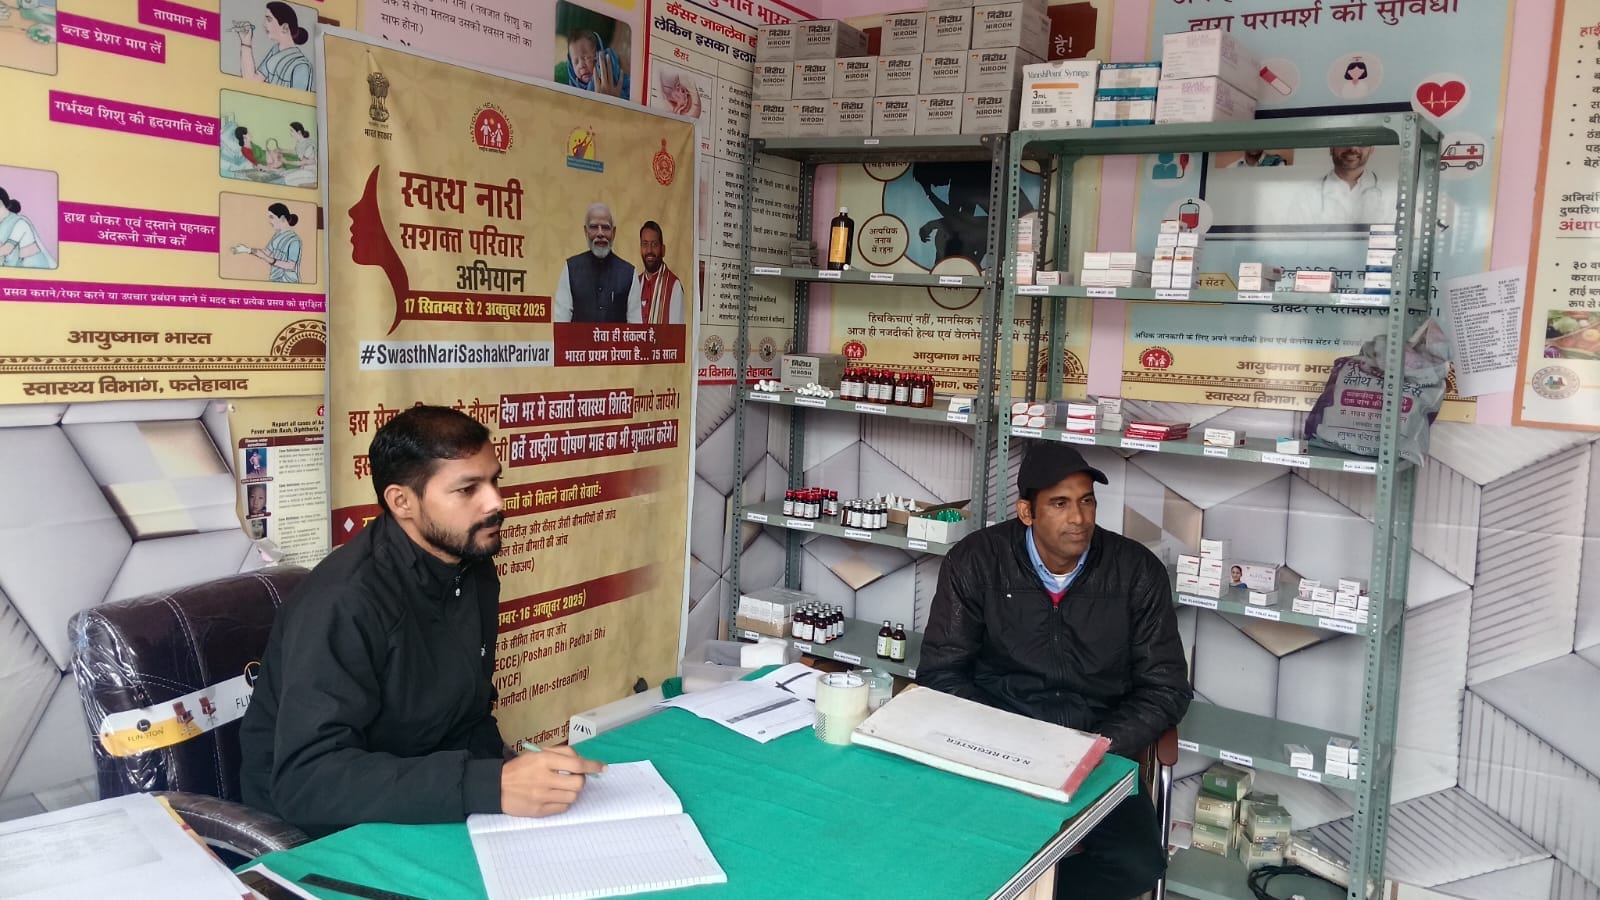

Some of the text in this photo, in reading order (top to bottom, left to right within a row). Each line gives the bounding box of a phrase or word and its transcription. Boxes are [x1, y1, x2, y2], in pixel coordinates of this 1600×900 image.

[154, 8, 208, 30] तापमान लें
[380, 12, 423, 35] साफ होना)
[412, 1, 456, 25] रोना मतलब
[503, 11, 520, 30] शिशु
[1241, 5, 1321, 30] परामर्श
[61, 24, 162, 55] ब्लड प्रेशर माप लें
[654, 16, 729, 55] लेकिन इसका
[700, 15, 745, 44] जानलेवा
[55, 98, 214, 136] गर्भस्थ शिशु की हृदयगति देखें
[399, 171, 523, 221] स्वस्थ नारी
[64, 211, 216, 235] हाथ धोकर एवं दस्ताने पहनकर
[98, 229, 139, 243] अंदरूनी
[170, 233, 187, 246] करें
[399, 222, 525, 259] सशक्त परिवार
[456, 259, 527, 293] अभियान
[3, 286, 27, 298] प्रसव
[31, 287, 81, 300] कराने/रेफर
[84, 288, 105, 300] करने
[108, 292, 118, 301] या
[121, 291, 148, 302] उपचार
[150, 291, 177, 303] प्रबंधन
[179, 293, 199, 304] करने
[209, 296, 226, 305] मदद
[229, 297, 241, 306] कर
[267, 298, 284, 308] प्रसव
[404, 298, 415, 313] 17
[418, 297, 463, 316] सितम्बर
[465, 297, 475, 316] से
[477, 301, 483, 316] 2
[523, 302, 546, 318] 2025
[916, 312, 934, 326] नहीं,
[937, 314, 974, 326] मानसिक
[67, 329, 212, 350] आयुष्मान भारत
[593, 327, 656, 345] सेवा ही संकल्प है,
[847, 327, 865, 337] आज
[868, 326, 876, 337] ही
[880, 327, 914, 339] नजदीकी
[937, 329, 952, 340] एवं
[360, 344, 550, 365] #SwasthNariSashaktParivar
[564, 350, 585, 363] भारत
[587, 349, 609, 363] प्रथम
[610, 347, 631, 363] प्रेरणा
[661, 349, 677, 361] साल
[912, 350, 983, 364] आयुष्मान भार
[1236, 360, 1334, 375] आयुष्मान भार
[23, 375, 249, 396] स्वास्थ्य विभाग, फतेहाबाद
[1204, 389, 1250, 403] स्वास्थ्य
[348, 410, 370, 436] इस
[502, 397, 519, 425] देश
[521, 398, 536, 421] भर
[548, 393, 575, 420] हजारों
[577, 396, 606, 418] स्वास्थ्य
[608, 391, 632, 416] शिविर
[633, 392, 654, 415] लगाये
[511, 436, 526, 461] 8वें
[529, 433, 558, 463] राष्ट्रीय
[560, 431, 587, 456] पोषण
[588, 430, 605, 453] माह
[606, 431, 617, 451] का
[619, 425, 629, 449] भी
[631, 421, 655, 454] शुभारंभ
[502, 491, 520, 511] च्चों
[522, 490, 533, 508] को
[535, 487, 558, 507] मिलने
[560, 484, 578, 503] वाली
[529, 523, 541, 537] और
[562, 588, 587, 610] 2025)
[494, 625, 606, 672] ECCE)/Poshan Bhi Padhai Bhi
[495, 672, 522, 692] (IYCF)
[528, 665, 590, 701] (Men-streaming)
[946, 737, 1001, 758] REGISTER
